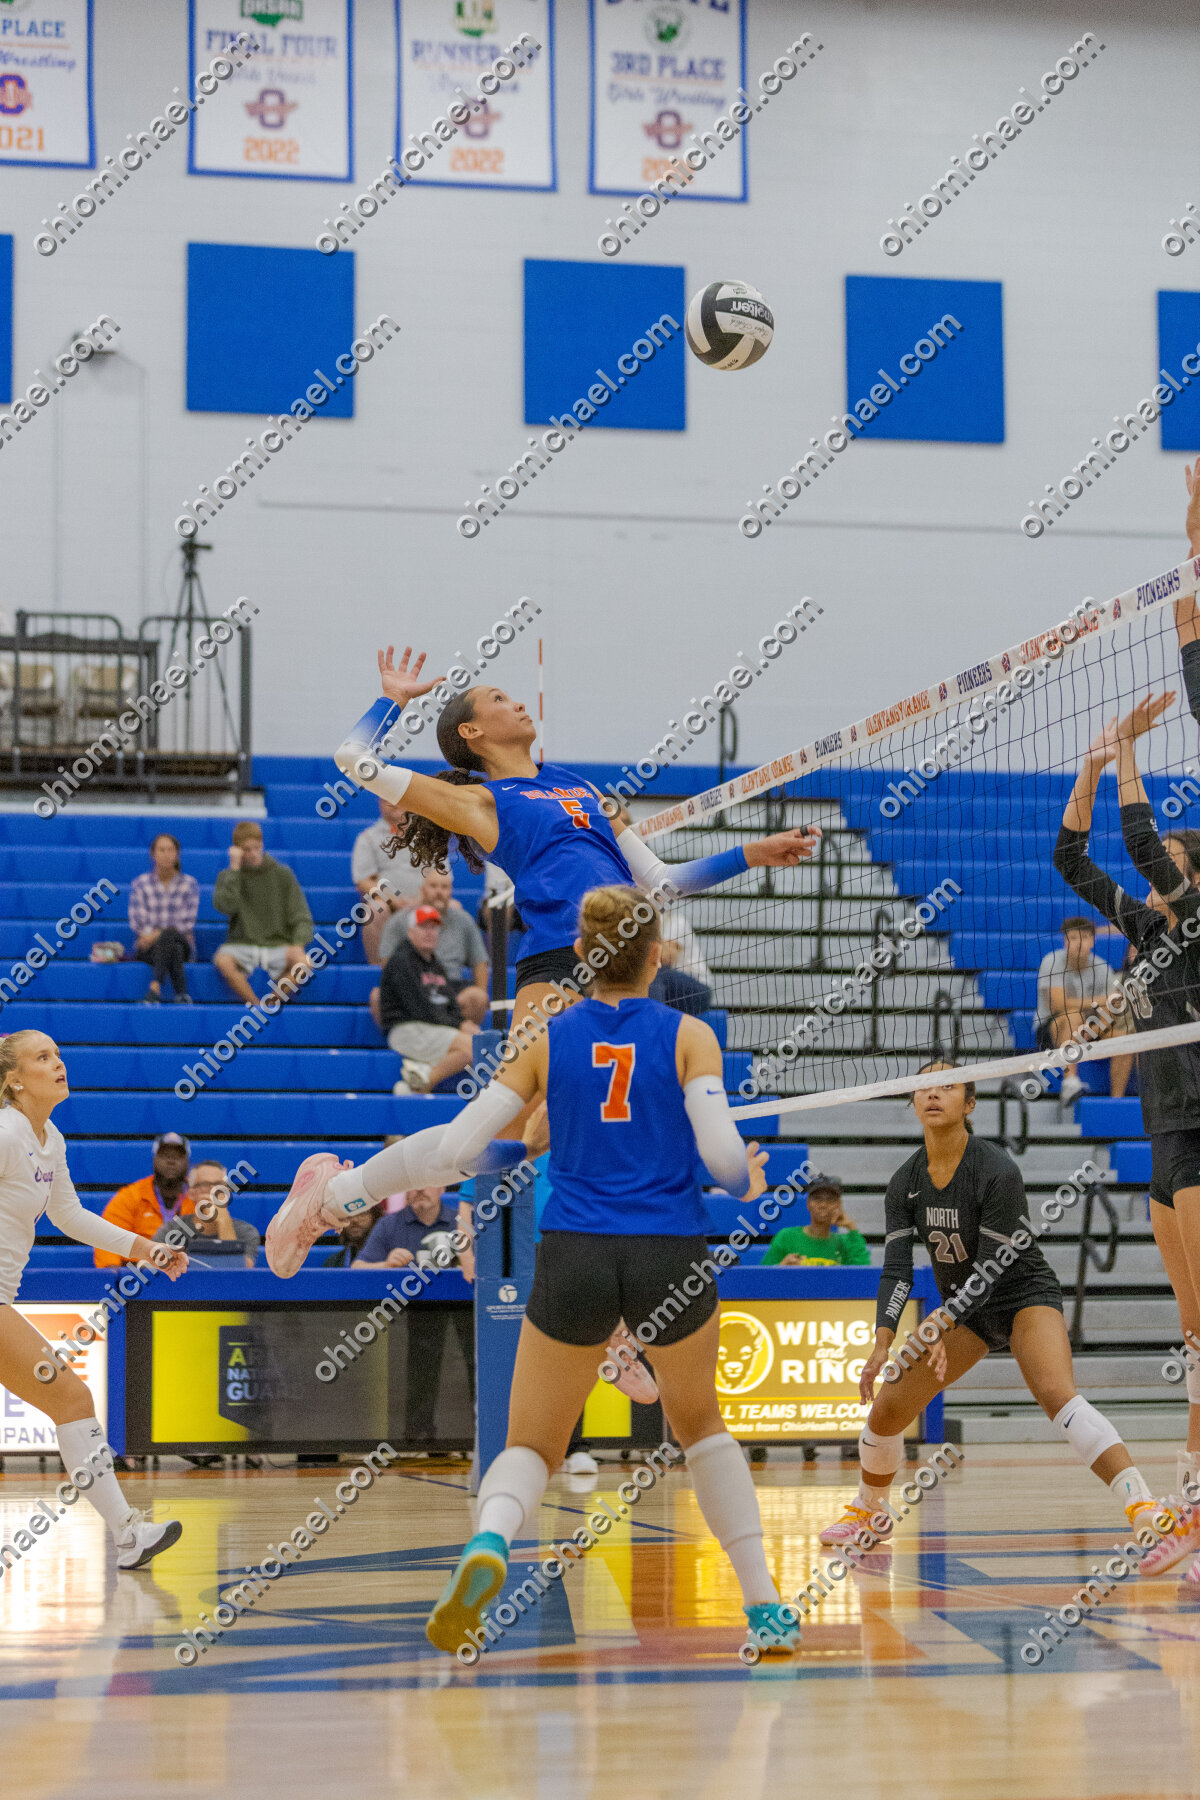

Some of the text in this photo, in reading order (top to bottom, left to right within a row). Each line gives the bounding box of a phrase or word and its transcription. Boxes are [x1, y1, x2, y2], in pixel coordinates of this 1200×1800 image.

[2, 19, 66, 38] PLACE
[657, 55, 726, 80] PLACE
[1136, 568, 1181, 610] PIONEERS
[956, 661, 993, 694] PIONEERS
[558, 800, 591, 829] 5
[592, 1042, 636, 1122] 7
[926, 1207, 959, 1229] NORTH
[928, 1231, 968, 1264] 21
[885, 1280, 911, 1321] PANTHERS
[738, 1404, 797, 1419] TEAMS
[0, 1427, 57, 1444] PANY
